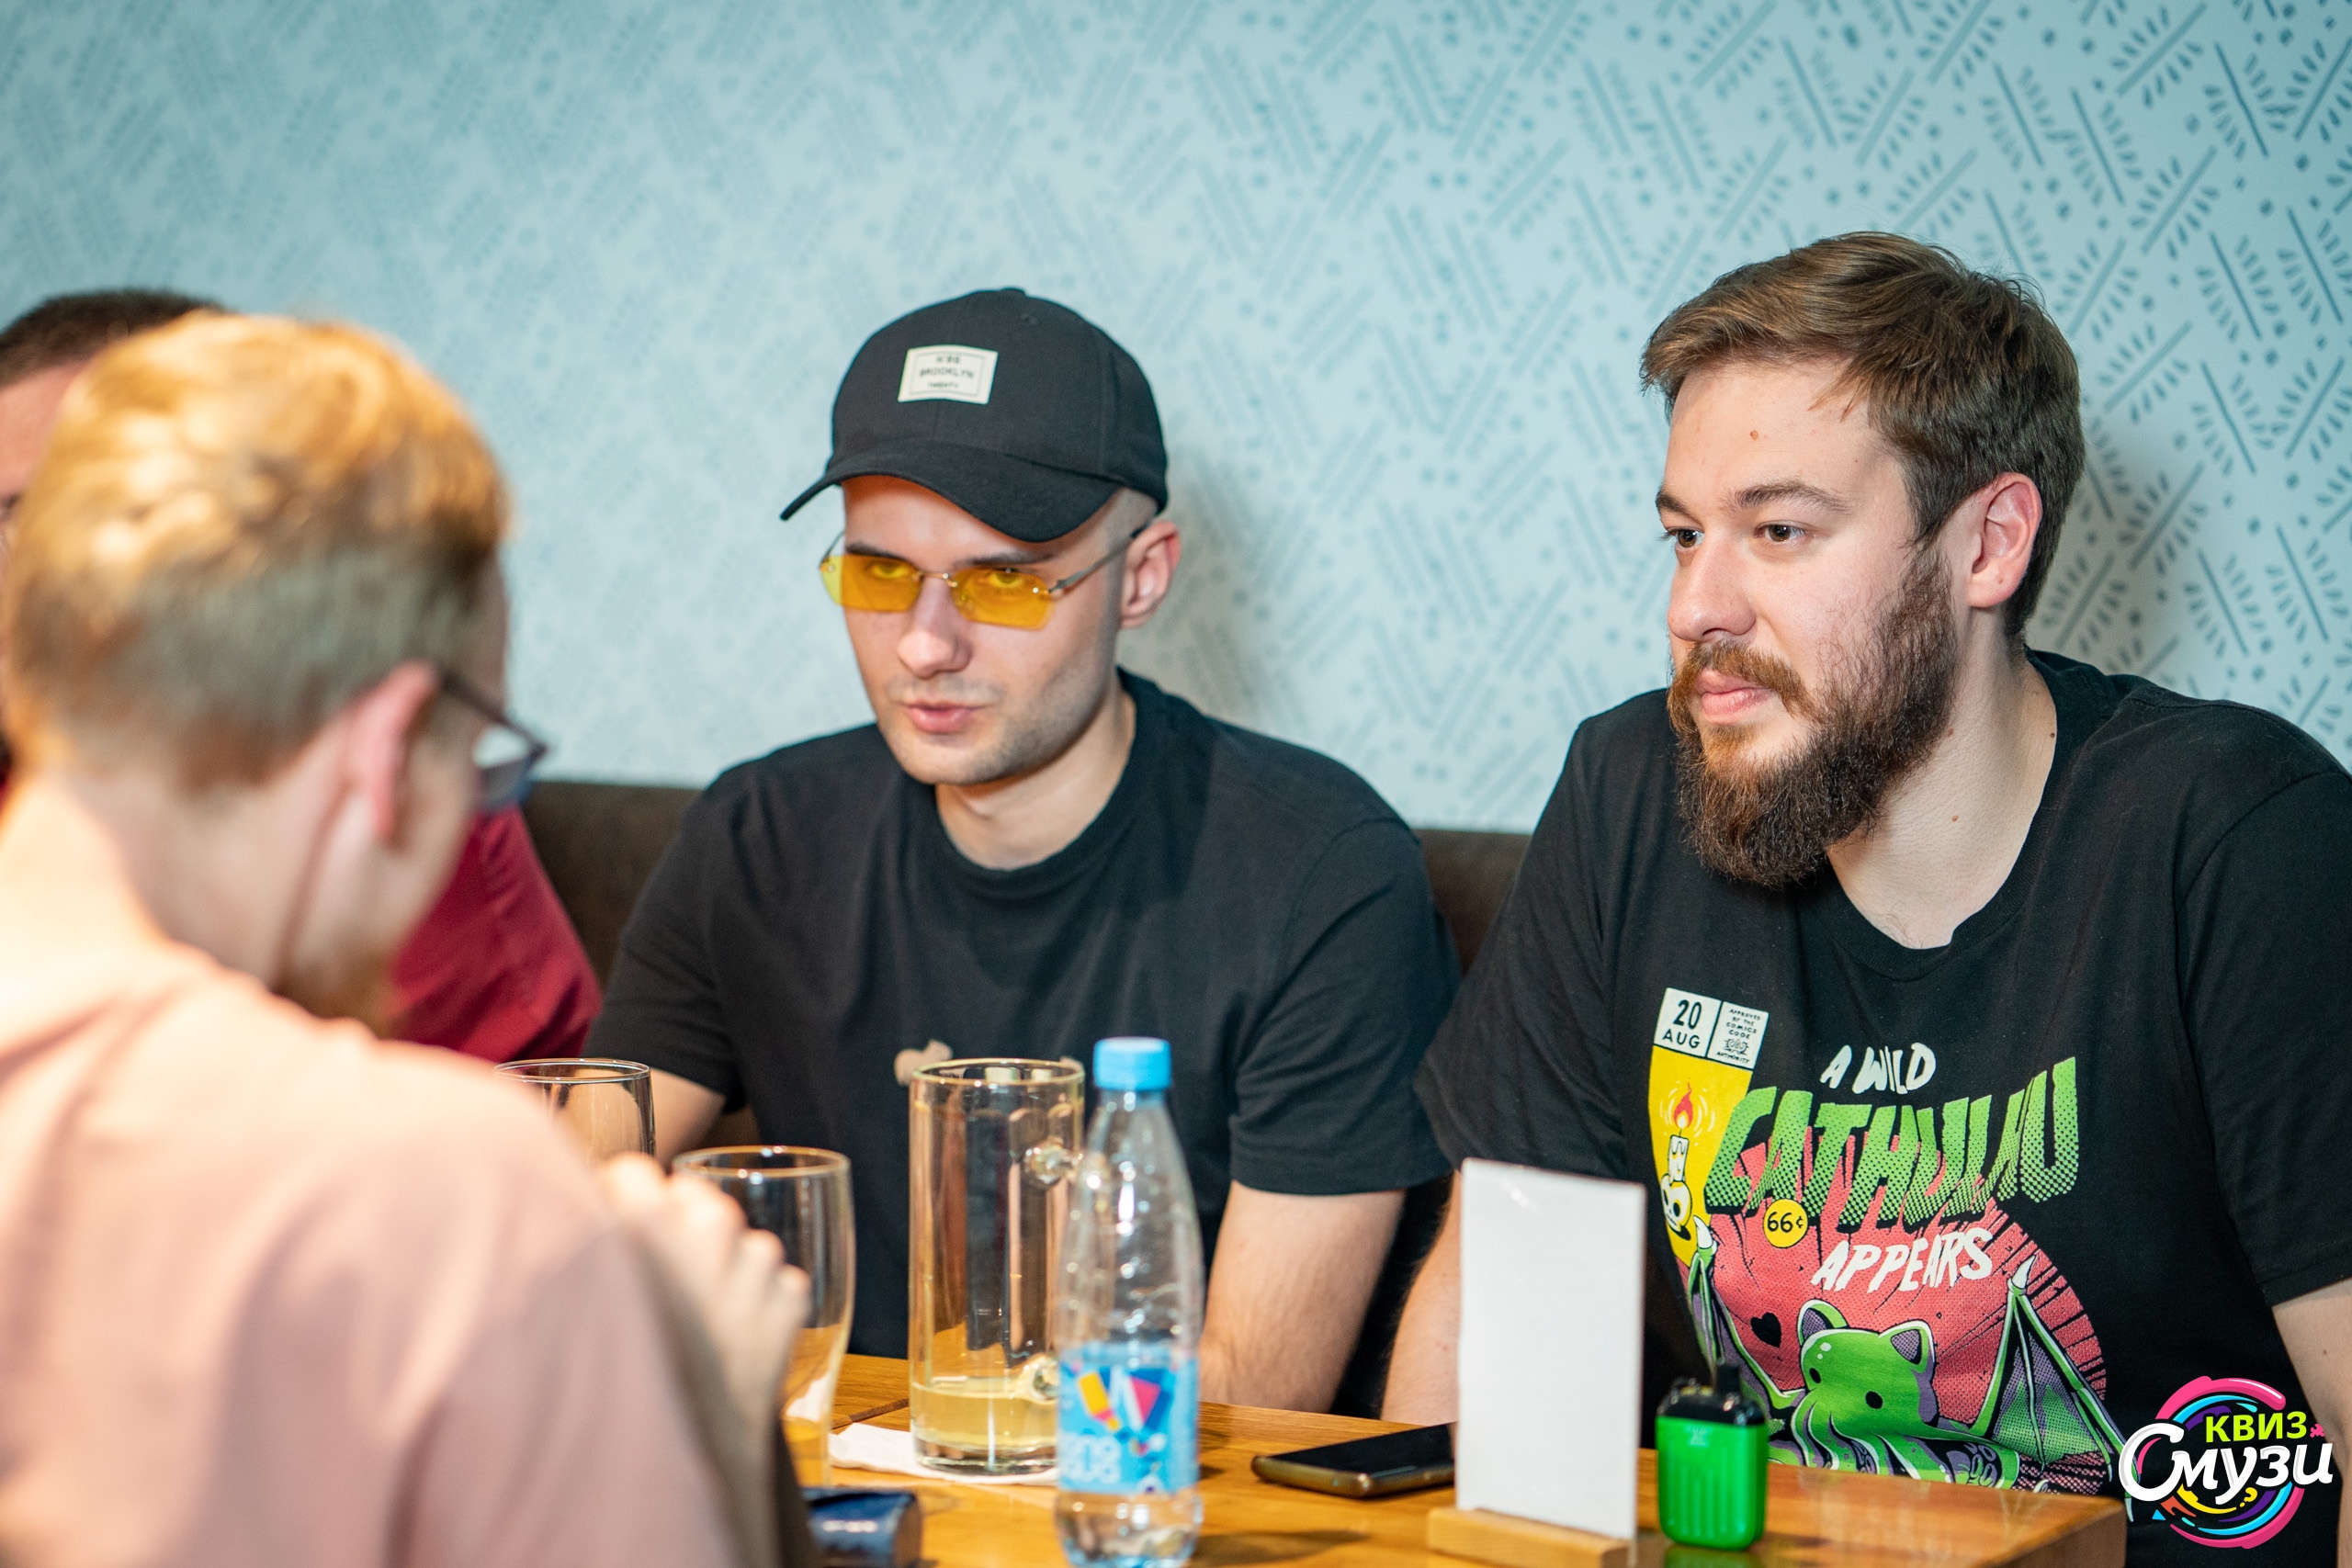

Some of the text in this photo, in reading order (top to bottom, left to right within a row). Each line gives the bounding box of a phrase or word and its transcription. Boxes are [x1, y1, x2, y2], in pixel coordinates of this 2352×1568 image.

[919, 367, 975, 378] BROOKLYN
[1673, 998, 1702, 1030] 20
[1729, 1009, 1761, 1021] APPROVED
[1725, 1021, 1758, 1034] COMICS
[1744, 1019, 1755, 1027] THE
[1662, 1028, 1702, 1049] AUG
[1728, 1029, 1750, 1040] CODE
[1715, 1051, 1750, 1065] AUTHORITY
[1820, 1042, 1937, 1095] A WILD
[1810, 1227, 1996, 1293] APPEARS
